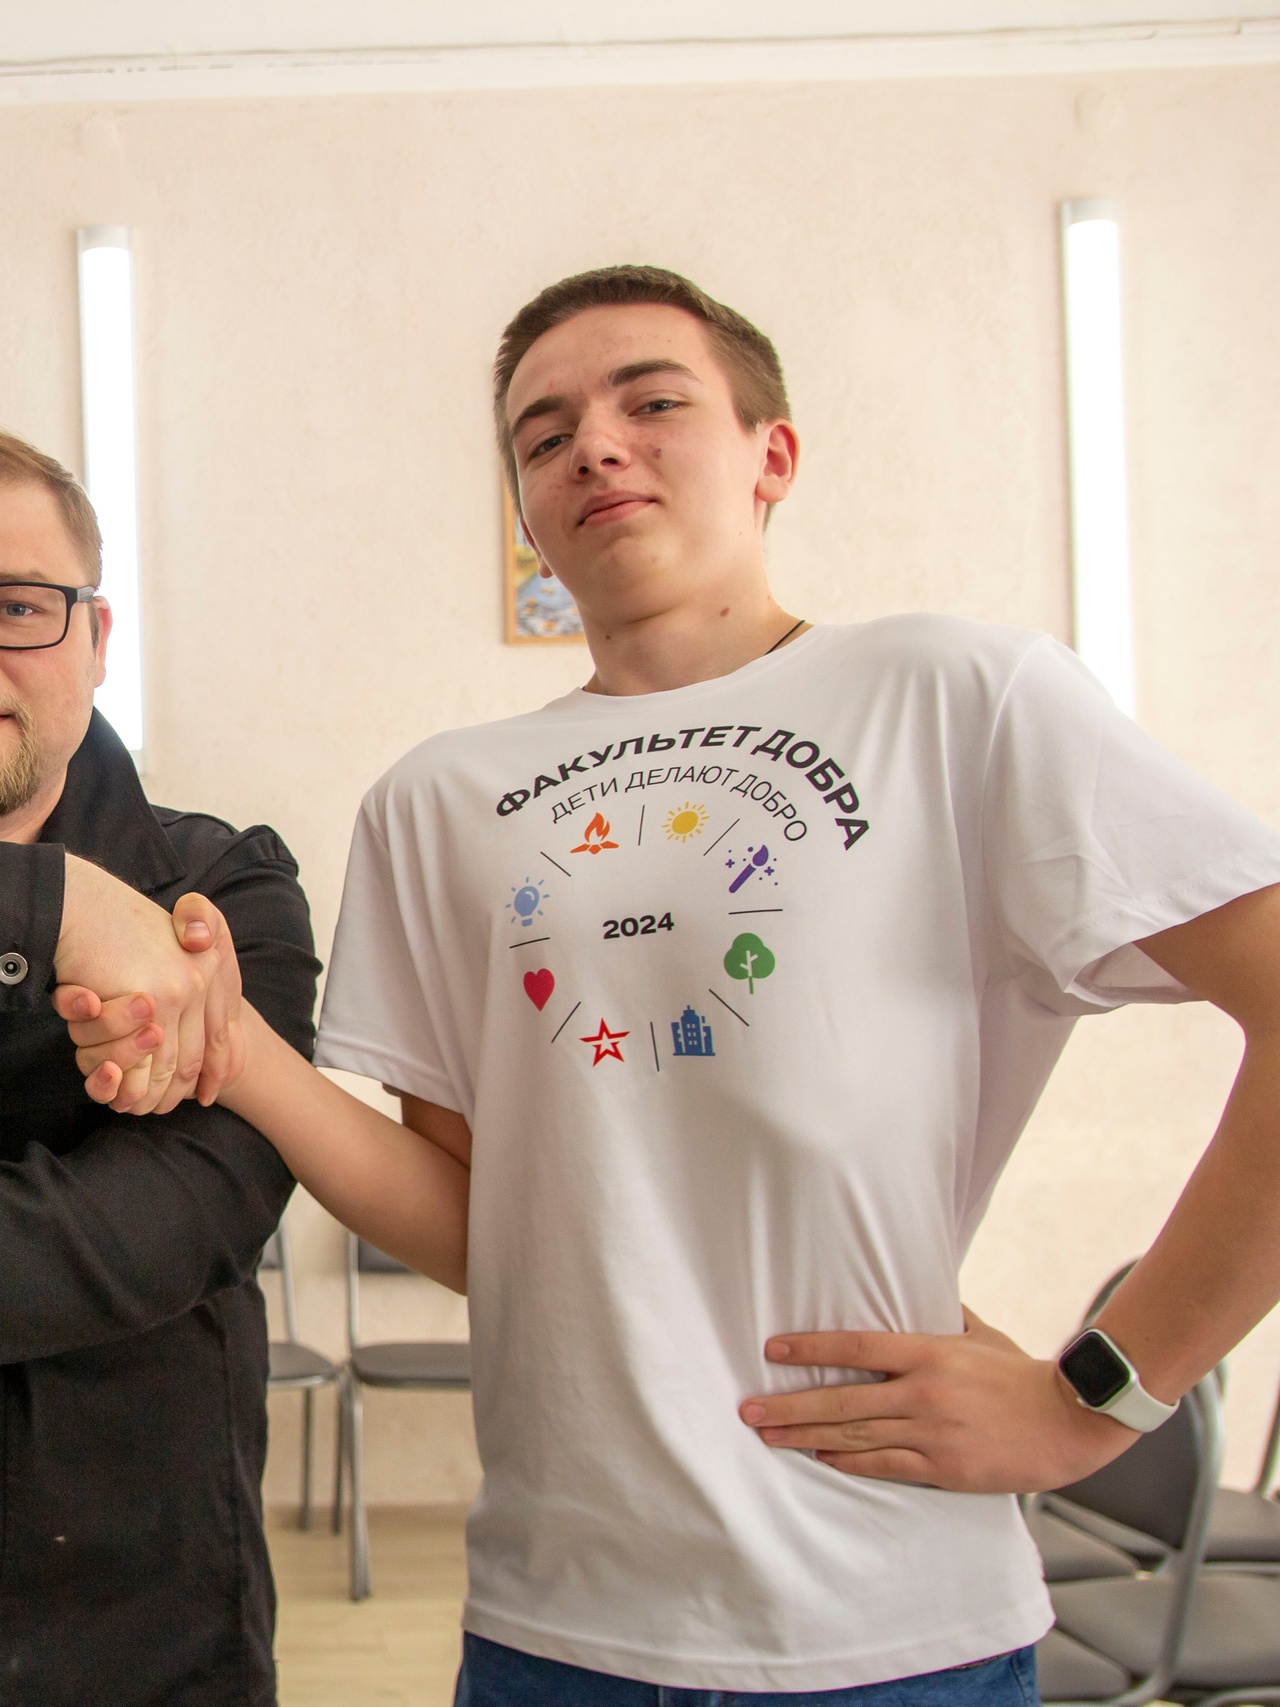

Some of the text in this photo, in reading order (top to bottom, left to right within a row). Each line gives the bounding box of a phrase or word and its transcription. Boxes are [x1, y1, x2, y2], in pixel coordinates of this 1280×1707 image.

[495, 725, 870, 851] ФАКУЛЬТЕТ ДОБРА
[550, 765, 808, 842] ДЕТИ ДЕЛАЮТ ДОБРО
[602, 912, 675, 940] 2024
